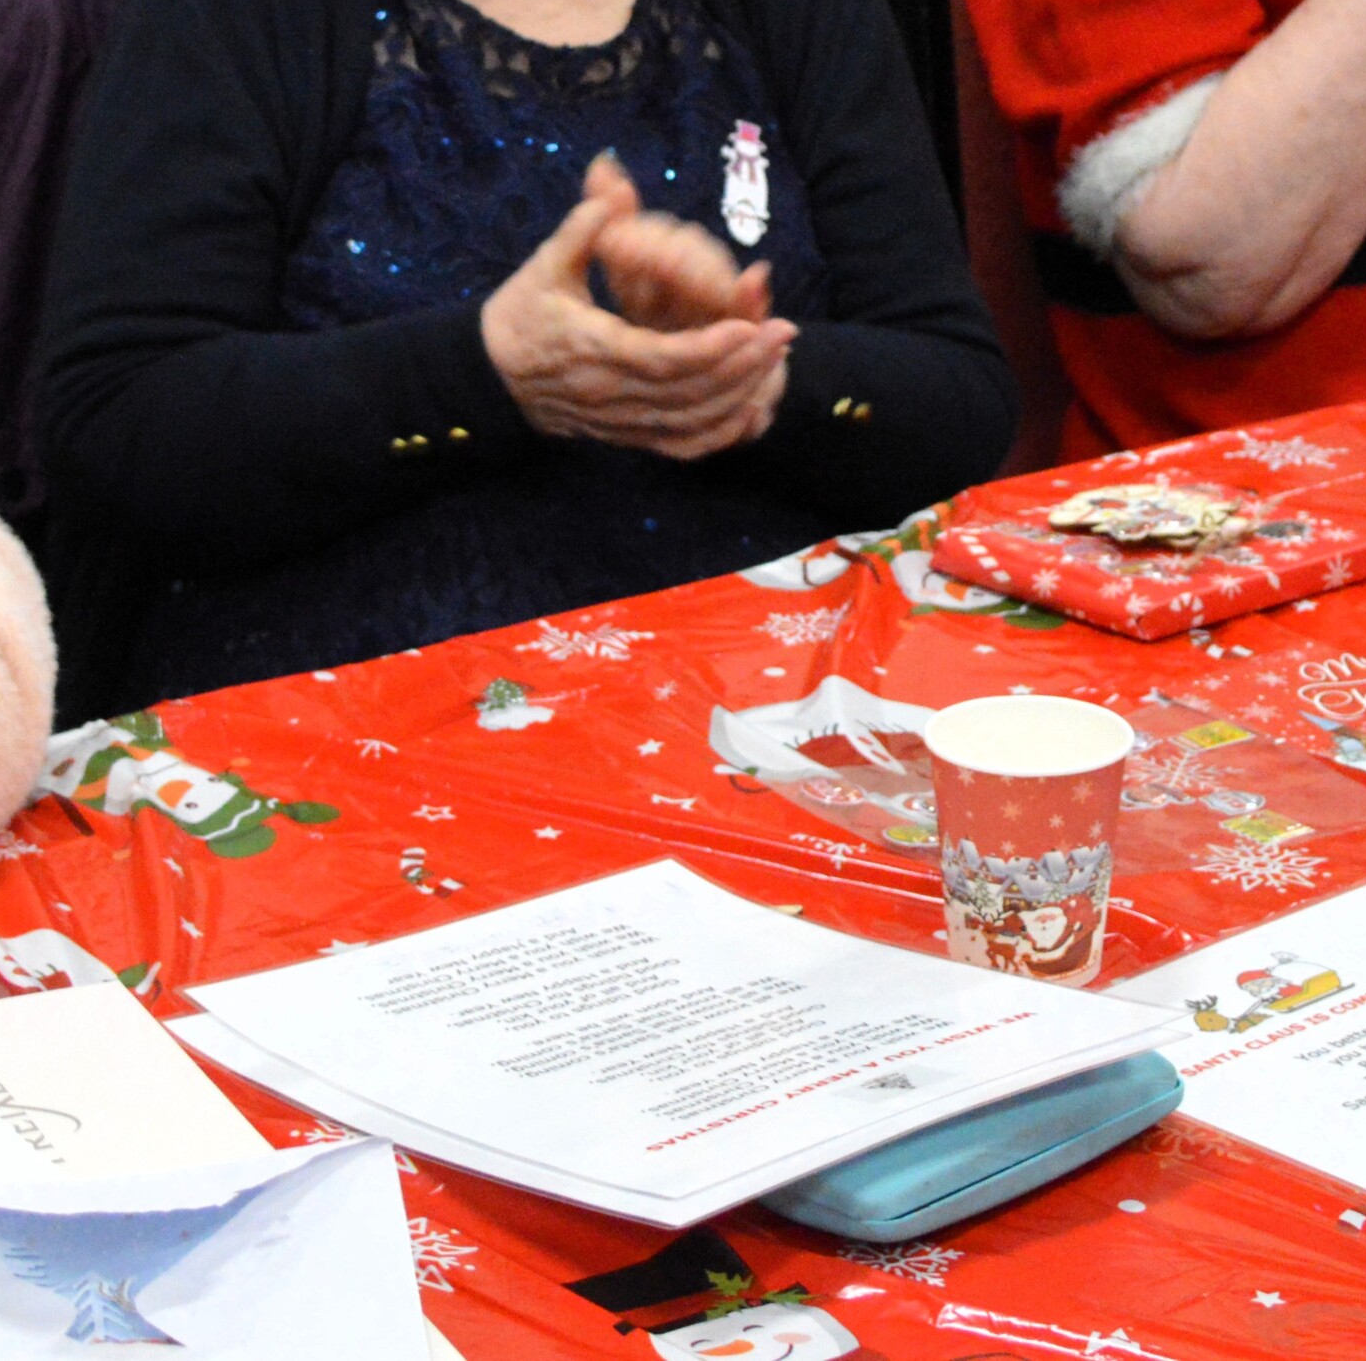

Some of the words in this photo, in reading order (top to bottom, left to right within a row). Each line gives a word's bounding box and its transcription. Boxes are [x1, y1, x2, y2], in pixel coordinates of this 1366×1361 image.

[1181, 1049, 1246, 1077] SANTA
[1244, 1023, 1307, 1050] CLAUS
[1304, 1012, 1331, 1026] IS
